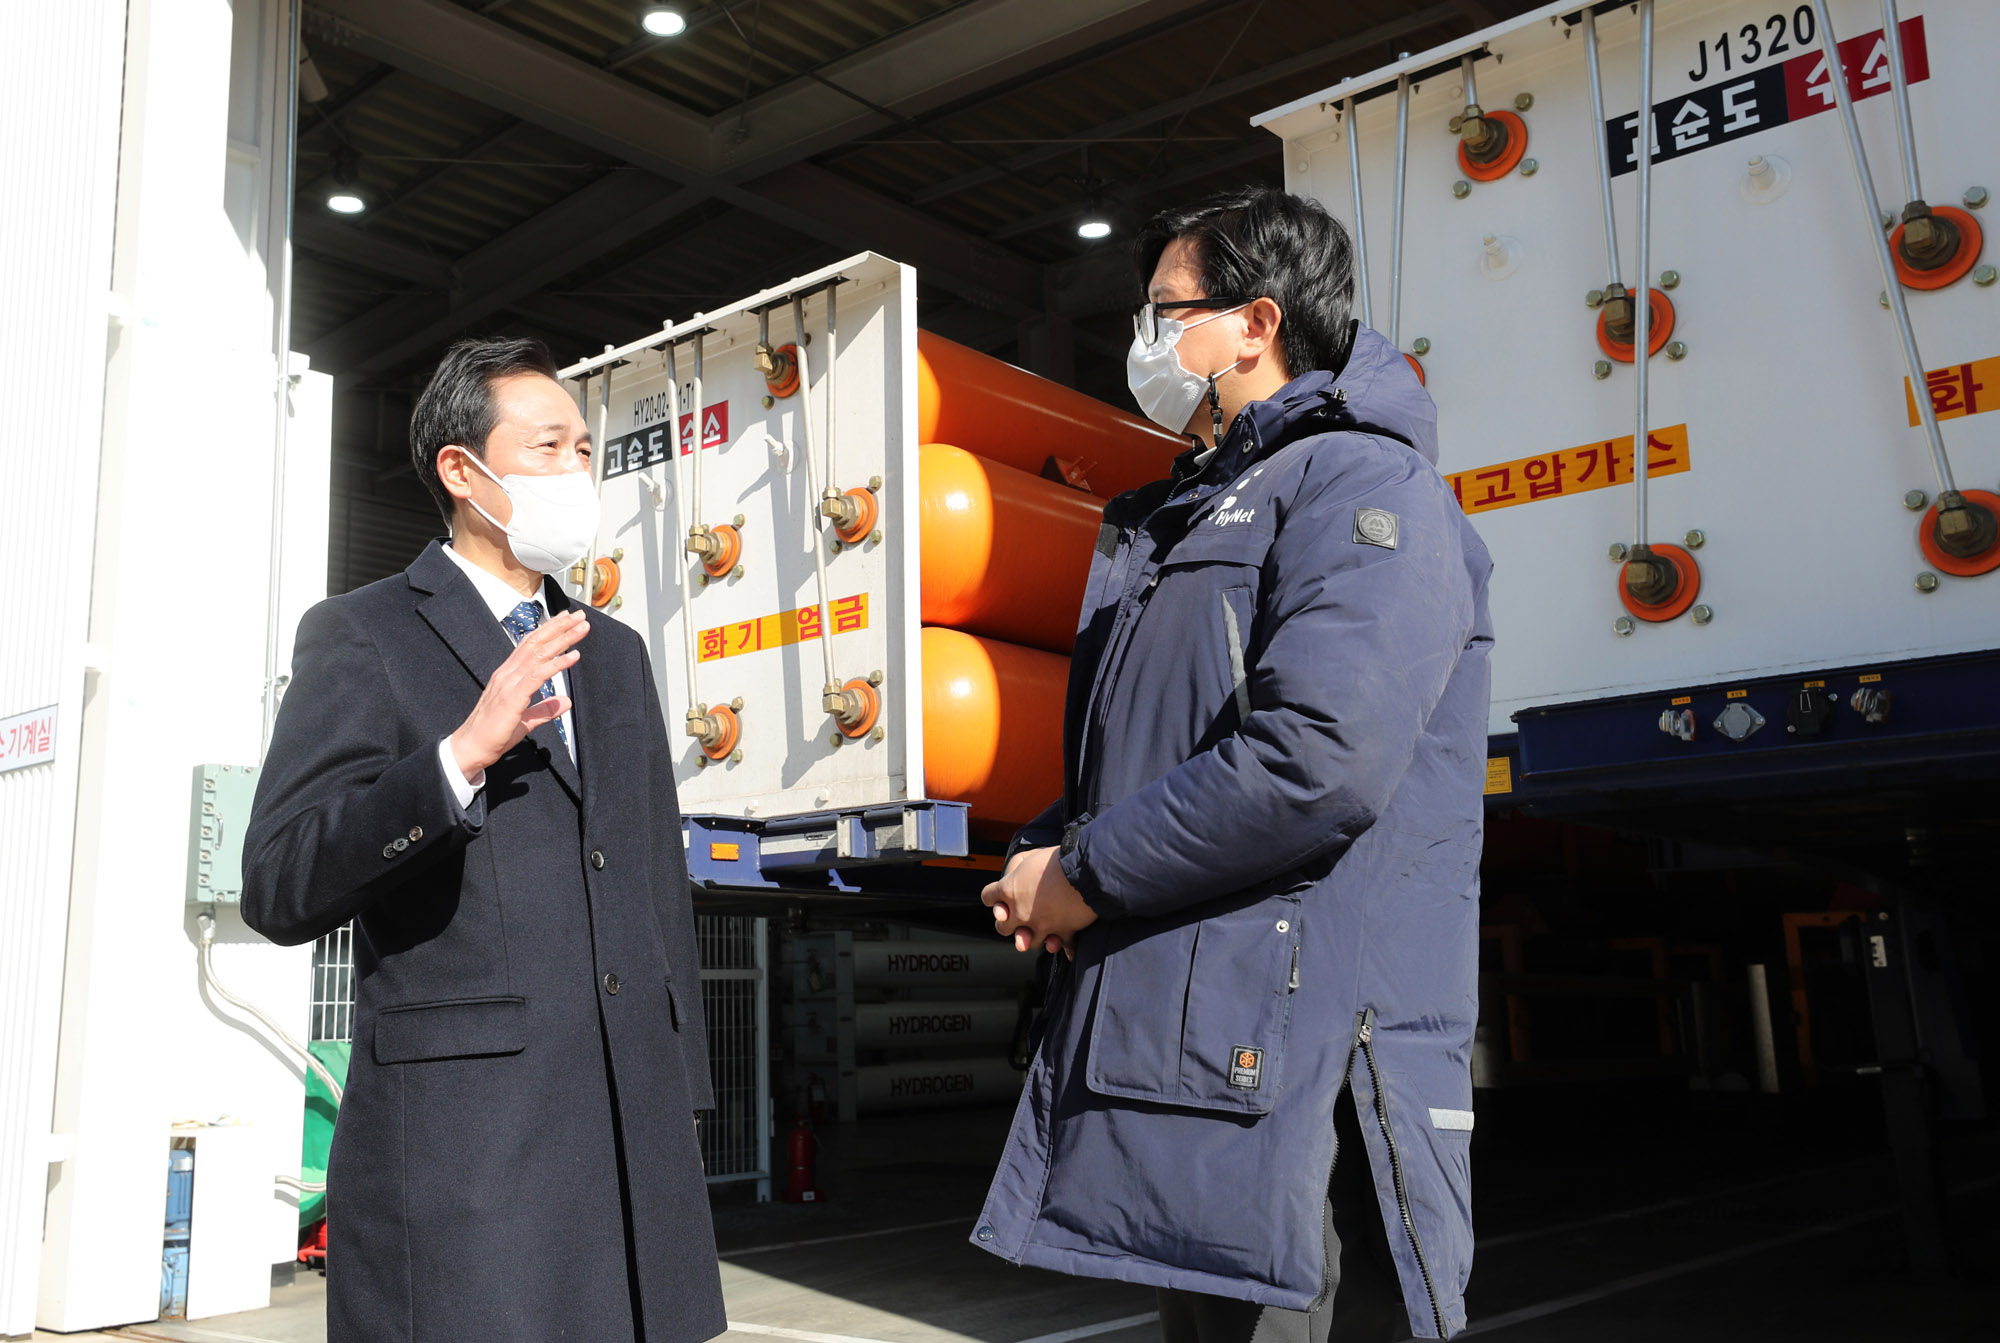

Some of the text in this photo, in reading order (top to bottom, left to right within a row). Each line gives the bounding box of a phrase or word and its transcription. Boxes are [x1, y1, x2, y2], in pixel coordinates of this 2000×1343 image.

[1688, 4, 1815, 82] J1320
[1624, 37, 1891, 163] 고순도 수소
[1926, 363, 1984, 415] 화
[607, 412, 720, 475] 고순도 수소
[1453, 434, 1677, 509] 고압가스
[1214, 508, 1256, 527] HyNet
[703, 595, 863, 659] 화기 엄금
[888, 954, 969, 973] HYDROGEN
[889, 1014, 972, 1035] HYDROGEN
[890, 1073, 974, 1097] HYDROGEN
